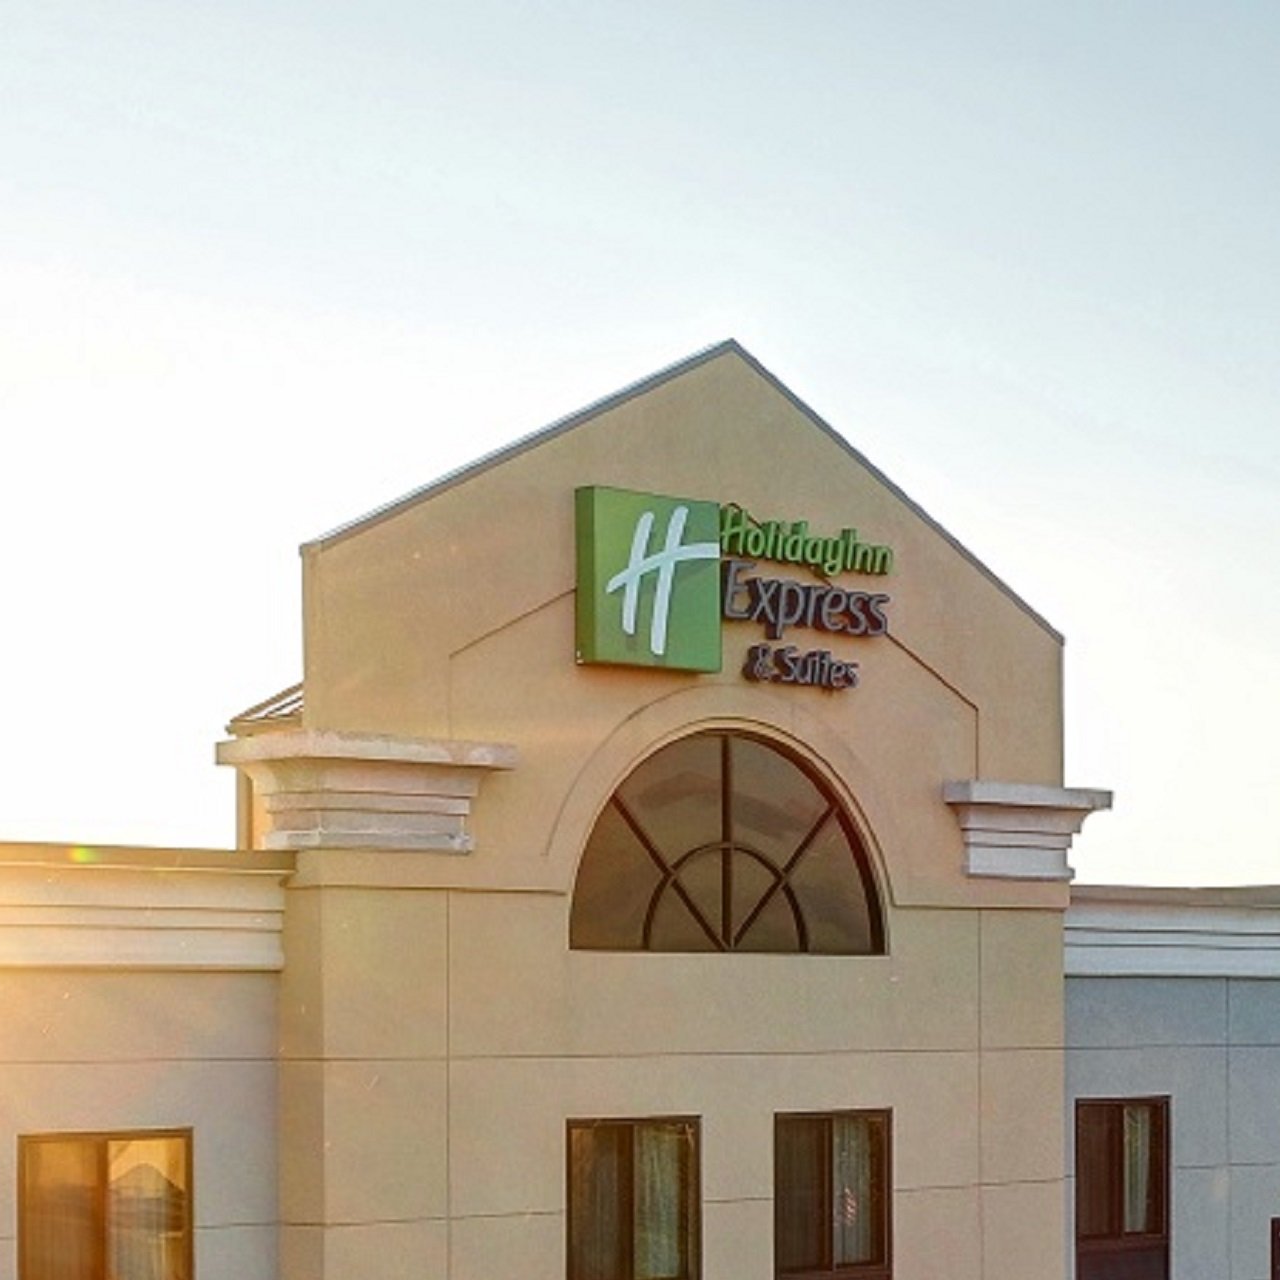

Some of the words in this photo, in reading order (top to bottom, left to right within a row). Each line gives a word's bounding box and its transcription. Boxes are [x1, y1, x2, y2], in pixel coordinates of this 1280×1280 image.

[721, 505, 844, 577] Holiday
[845, 528, 893, 575] Inn
[606, 505, 720, 656] H
[722, 560, 890, 639] Express
[745, 645, 773, 681] &
[775, 647, 859, 689] Suites
